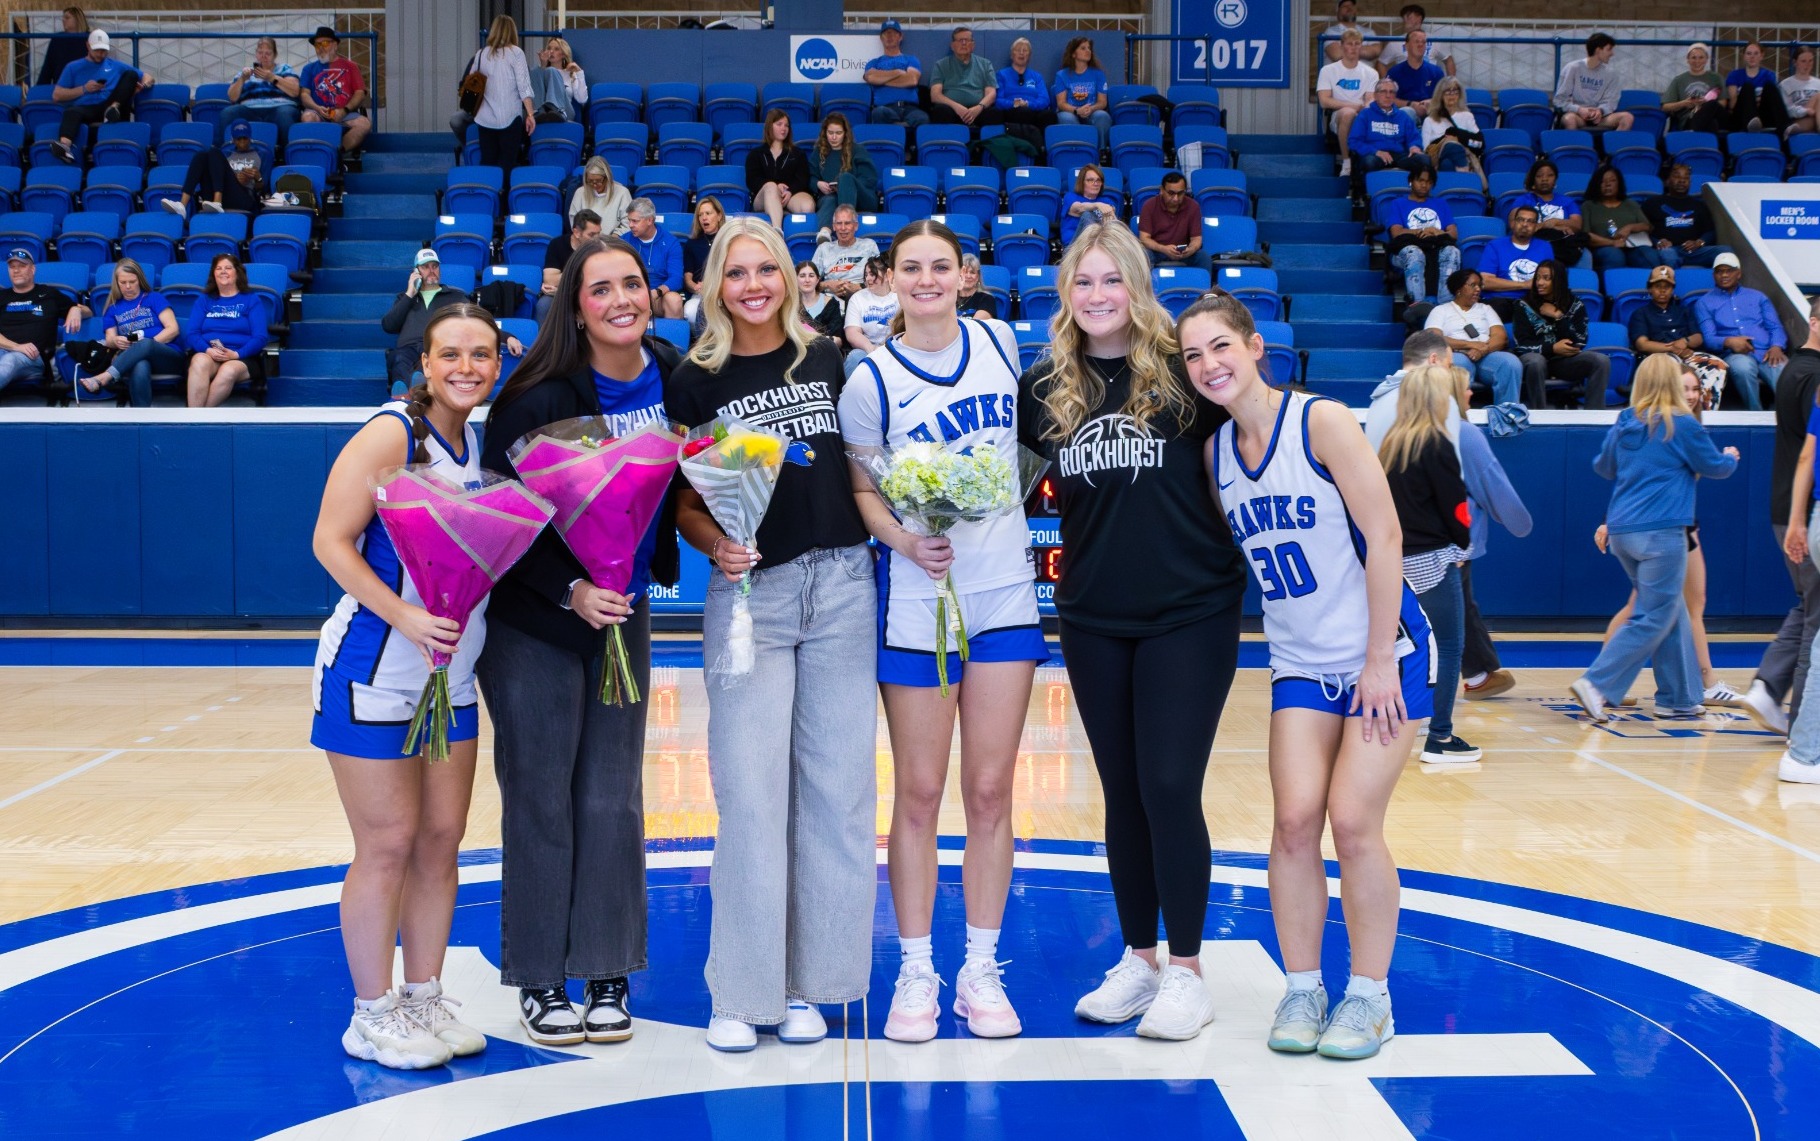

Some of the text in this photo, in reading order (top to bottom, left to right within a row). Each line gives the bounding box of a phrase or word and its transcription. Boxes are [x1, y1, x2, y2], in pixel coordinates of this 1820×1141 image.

[800, 58, 836, 70] NCAA
[1194, 39, 1268, 70] 2017
[1766, 216, 1820, 225] LOCKER ROOM
[1781, 207, 1805, 216] MEN'S
[761, 406, 805, 421] UNIVERSITY
[1060, 438, 1167, 478] ROCKHURST
[1227, 495, 1316, 545] HAWKS
[1250, 541, 1318, 601] 30
